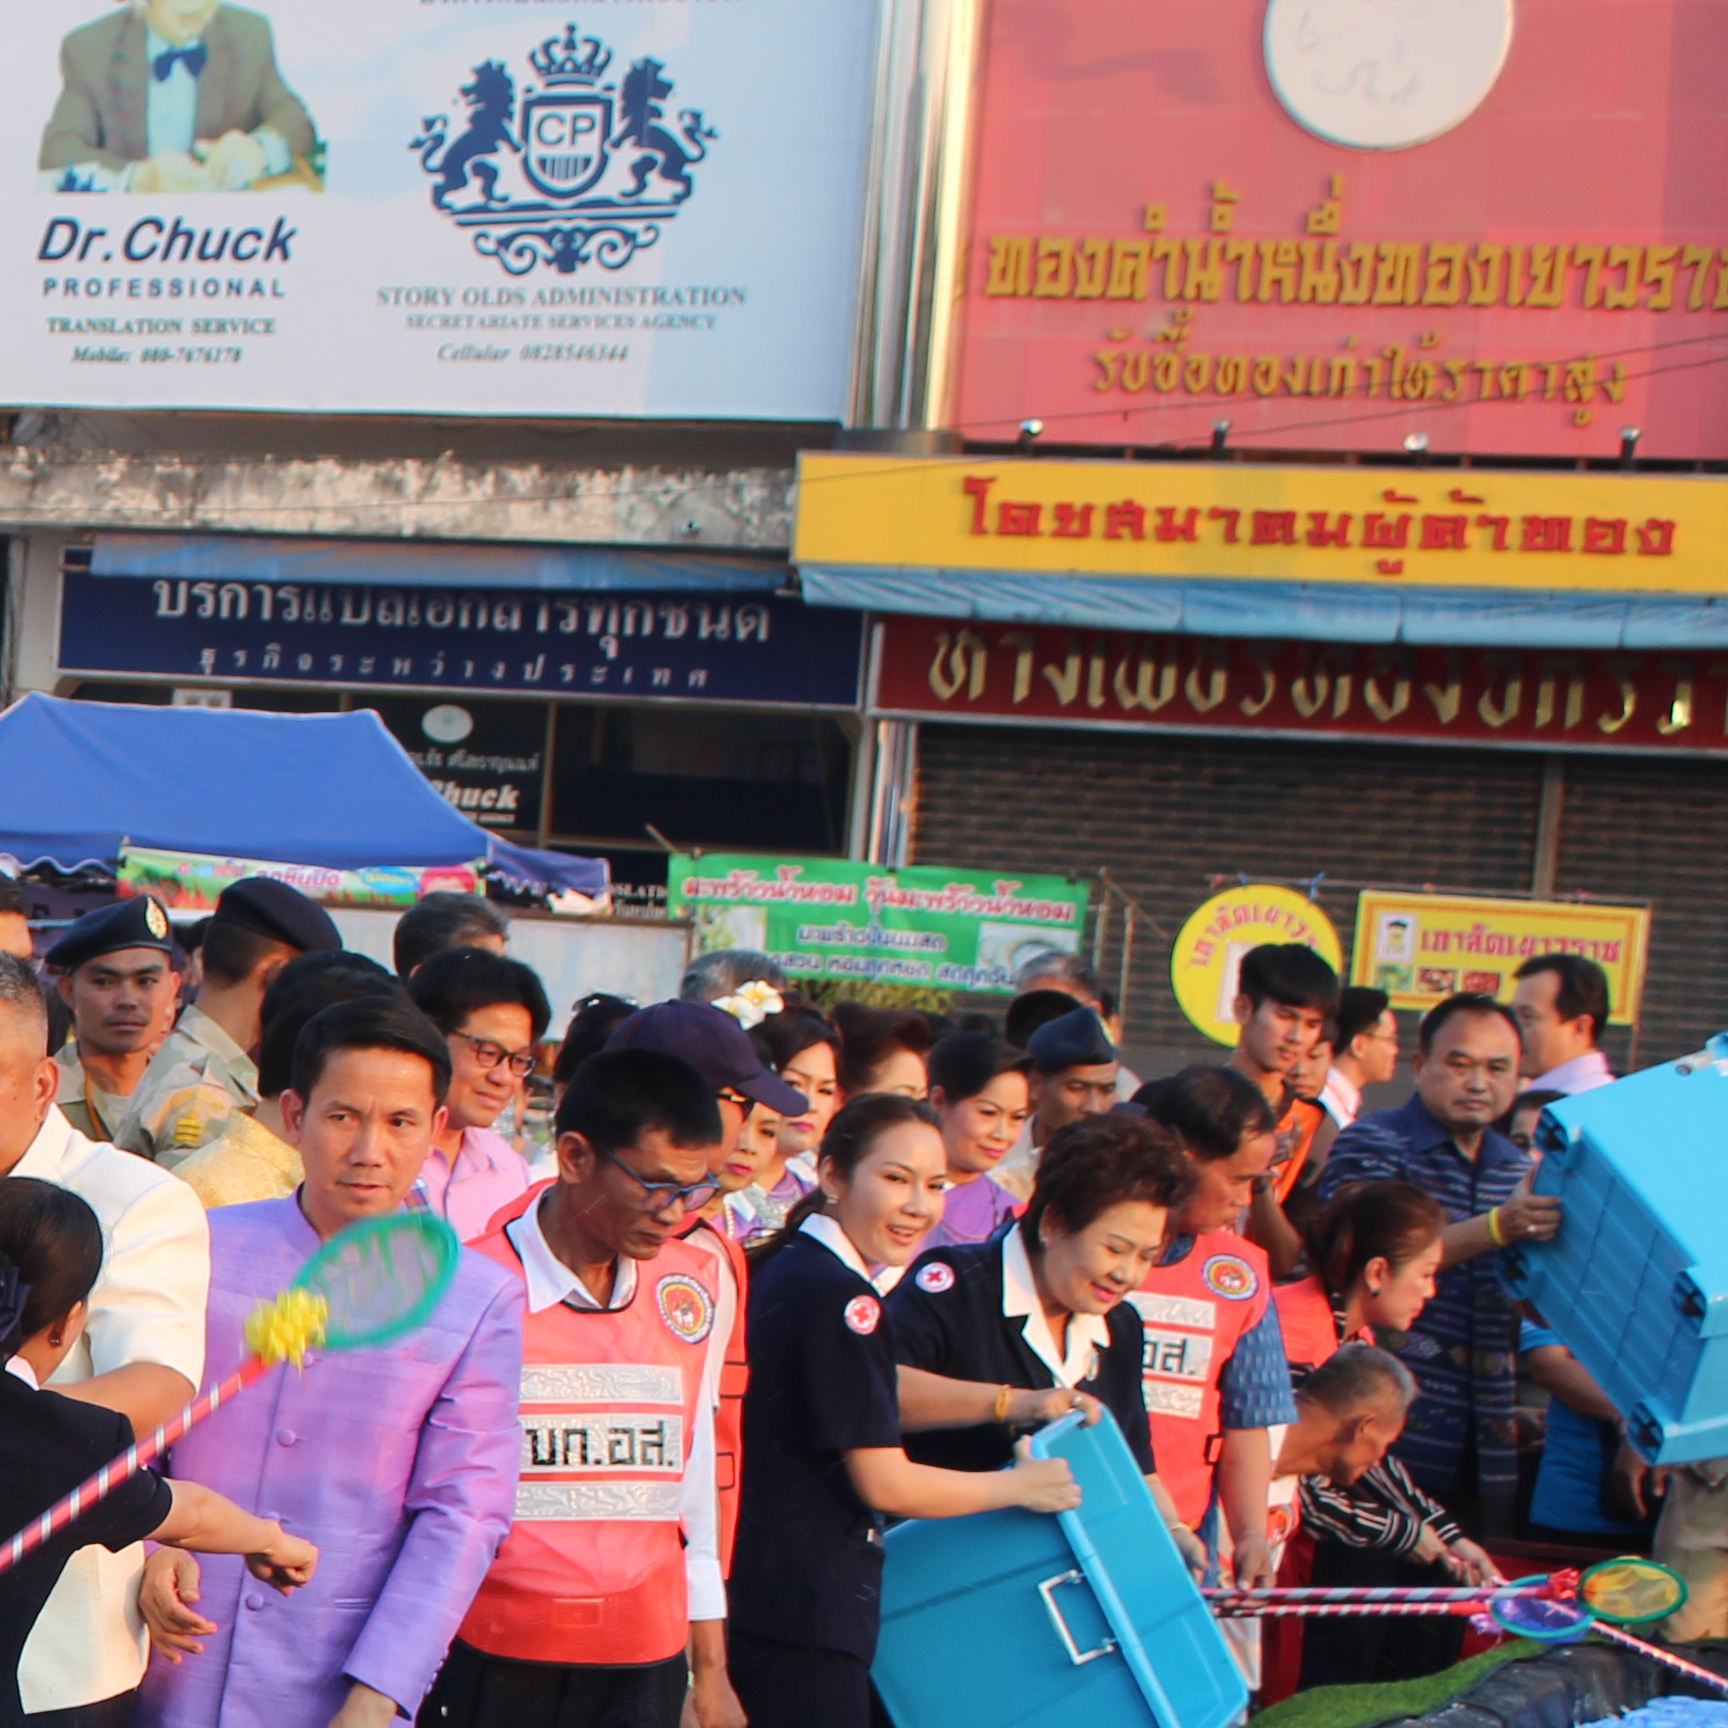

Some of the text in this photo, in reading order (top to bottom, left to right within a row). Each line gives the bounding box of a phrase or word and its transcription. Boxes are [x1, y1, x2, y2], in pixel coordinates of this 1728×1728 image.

[537, 111, 597, 146] CP
[37, 215, 297, 261] Dr.Chuck
[43, 277, 286, 297] PROFESSIONAL
[376, 286, 748, 307] STORY OLDS ADMINISTRATION
[47, 317, 276, 334] TRANSLATION SERVICE
[547, 313, 636, 331] SERVICES
[639, 313, 718, 331] AGENCY
[437, 342, 510, 362] Cellular
